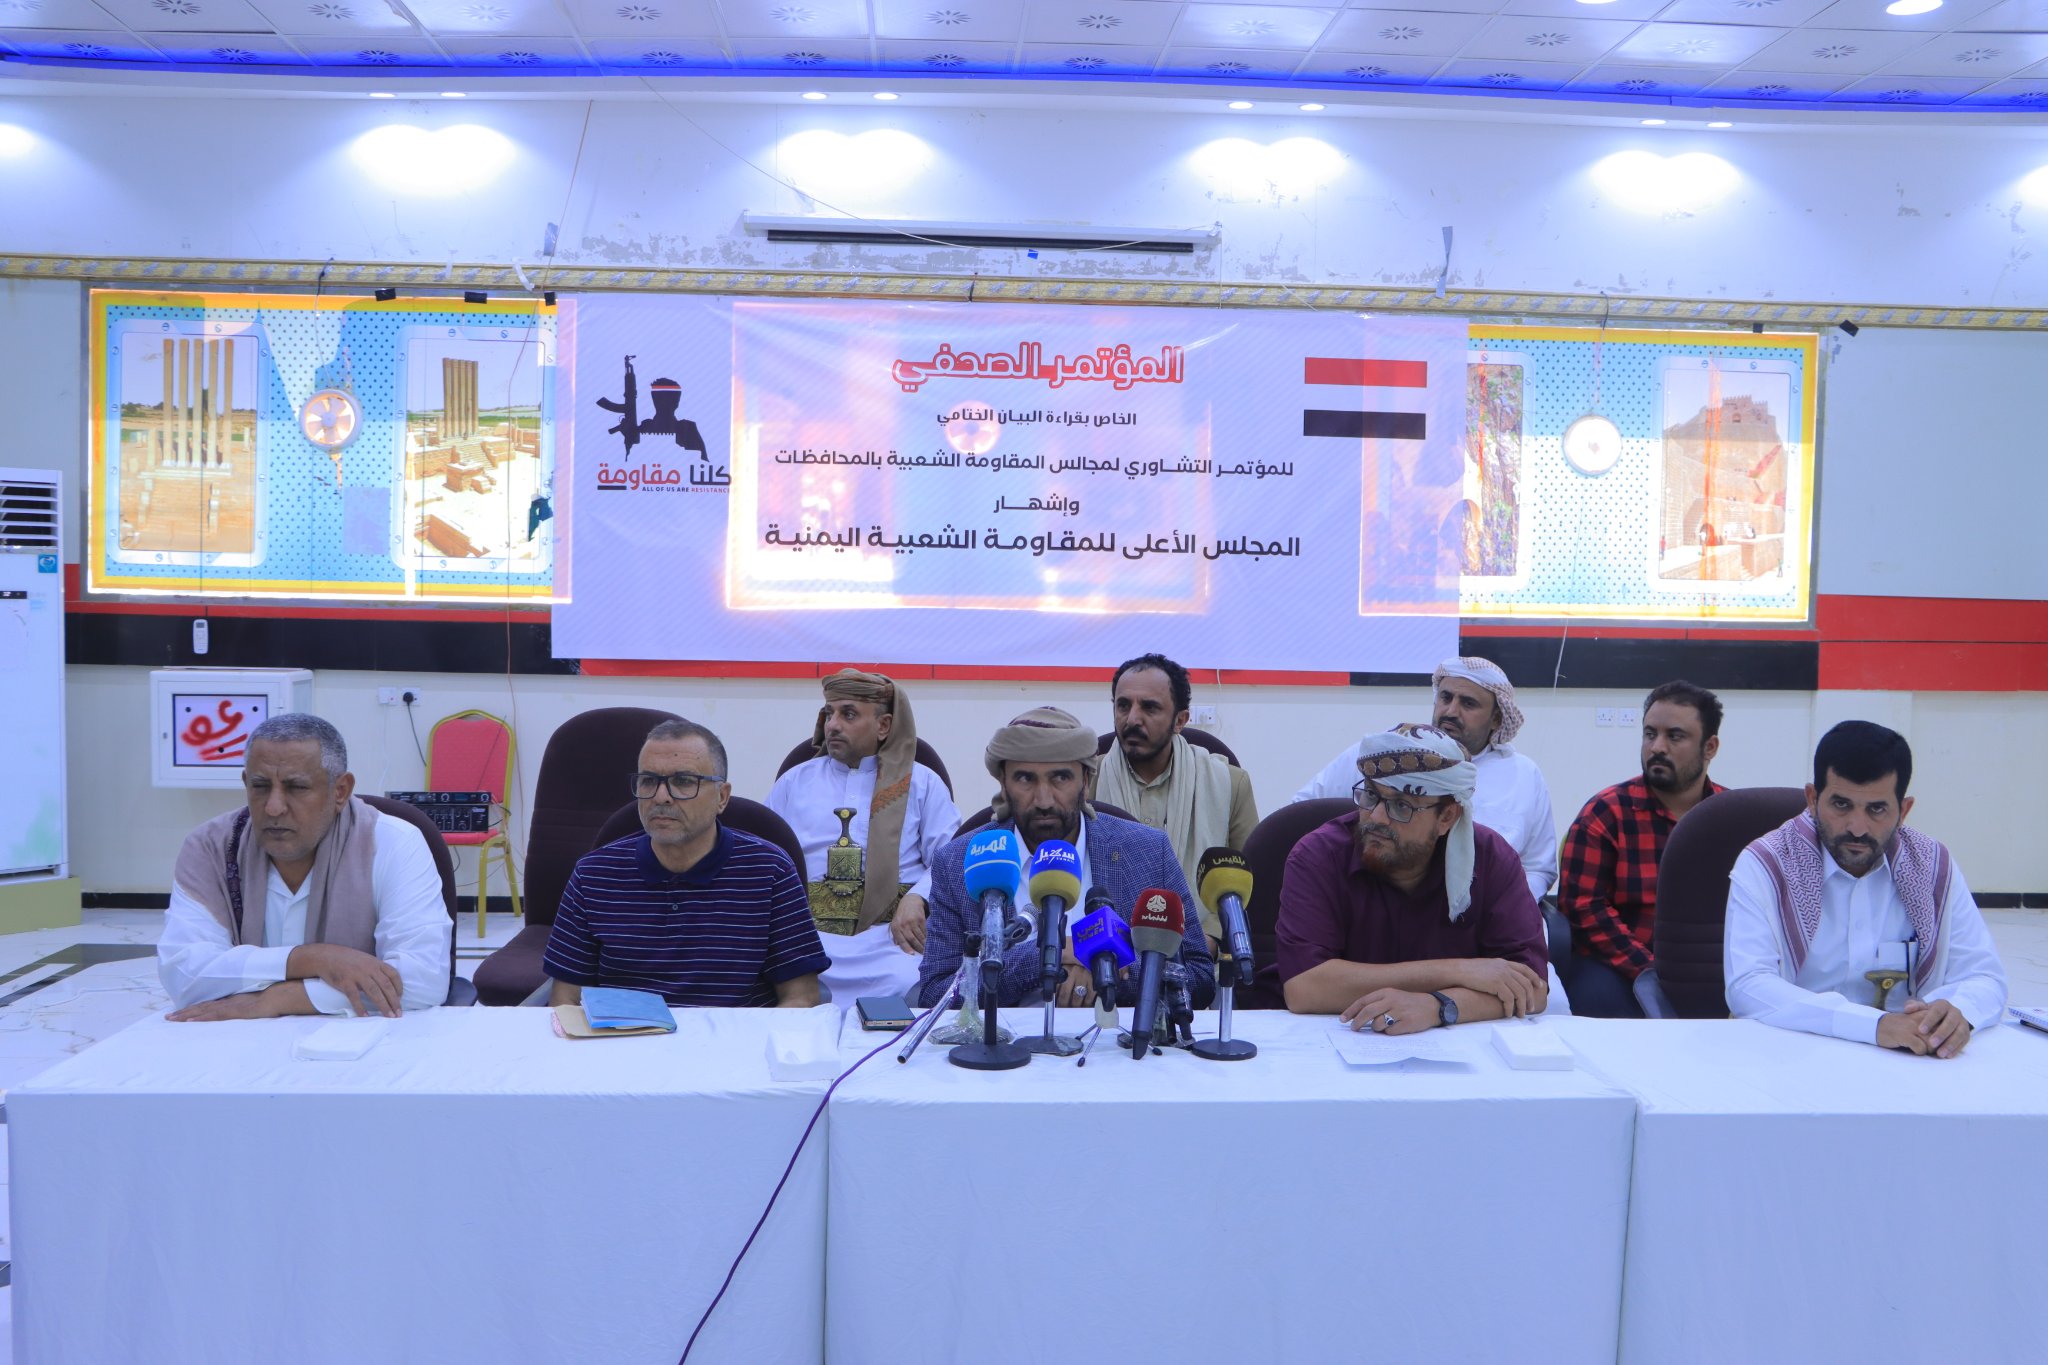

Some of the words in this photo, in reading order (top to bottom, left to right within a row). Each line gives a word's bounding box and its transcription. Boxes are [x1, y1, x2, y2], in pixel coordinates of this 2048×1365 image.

[892, 341, 1042, 392] الصحفي
[1049, 344, 1184, 390] المؤتمر
[936, 407, 994, 427] الختامي
[997, 408, 1042, 426] البيان
[1045, 410, 1090, 428] بقراءة
[1093, 411, 1137, 428] الخاص
[774, 448, 883, 471] بالمحافظات
[886, 448, 961, 471] الشعبية
[964, 452, 1045, 473] المقاومة
[1048, 455, 1120, 476] لمجالس
[1123, 455, 1212, 481] التشاوري
[1215, 459, 1294, 480] للمؤتمر
[597, 463, 681, 490] مقاومة
[690, 463, 732, 486] كلنا
[992, 492, 1080, 518] وإشهار
[764, 523, 861, 554] اليمنية
[867, 523, 977, 555] الشعبية
[983, 527, 1116, 557] للمقاومة
[1122, 529, 1197, 561] الأعلى
[1202, 535, 1300, 562] المجلس
[1212, 855, 1246, 866] بلقيس
